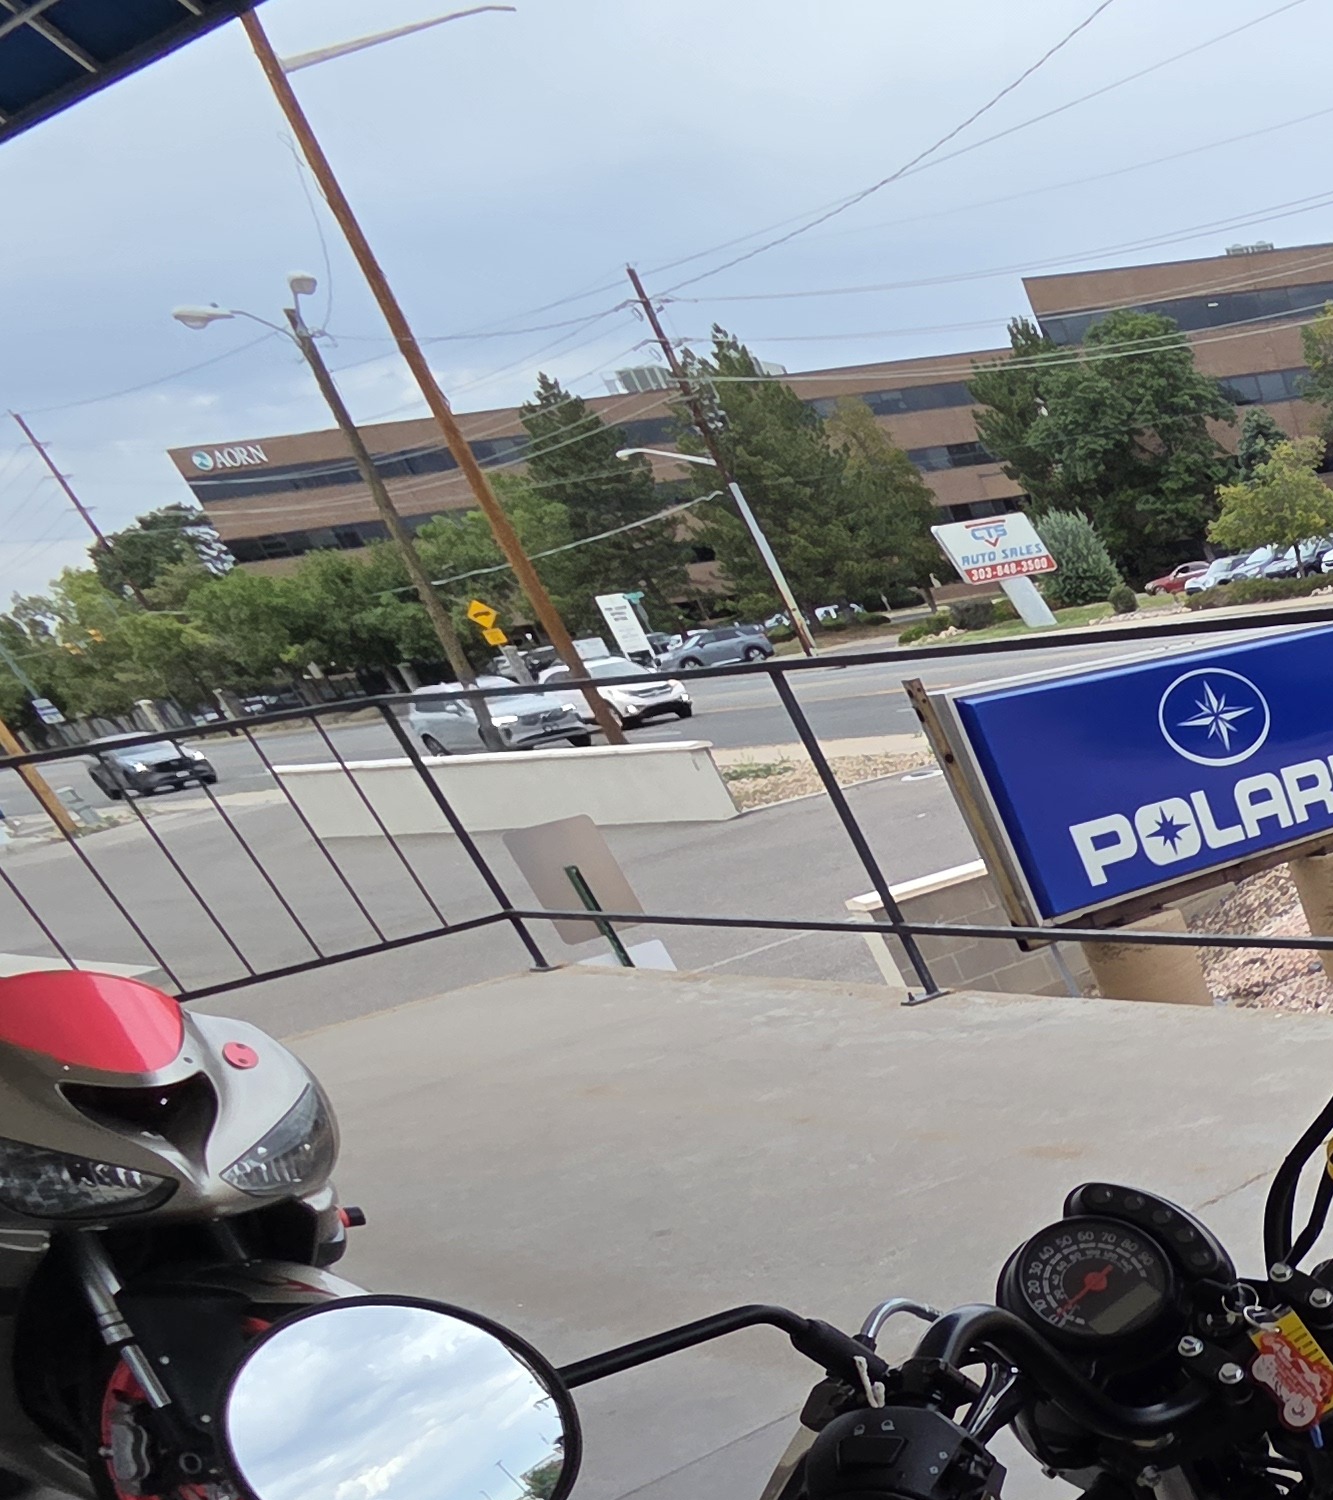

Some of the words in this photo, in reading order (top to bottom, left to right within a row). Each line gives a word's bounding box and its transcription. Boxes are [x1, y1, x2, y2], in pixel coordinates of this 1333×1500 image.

[214, 445, 269, 469] AORN
[971, 524, 1008, 541] CTS
[961, 551, 996, 567] AUTO
[1002, 543, 1043, 559] SALES
[1055, 1235, 1073, 1249] 50
[1077, 1230, 1095, 1242] 60
[1101, 1231, 1117, 1244] 70
[1039, 1245, 1054, 1261] 40
[1120, 1238, 1139, 1253] 80
[1137, 1251, 1155, 1267] 90
[1029, 1261, 1044, 1277] 30
[1027, 1279, 1041, 1295] 20
